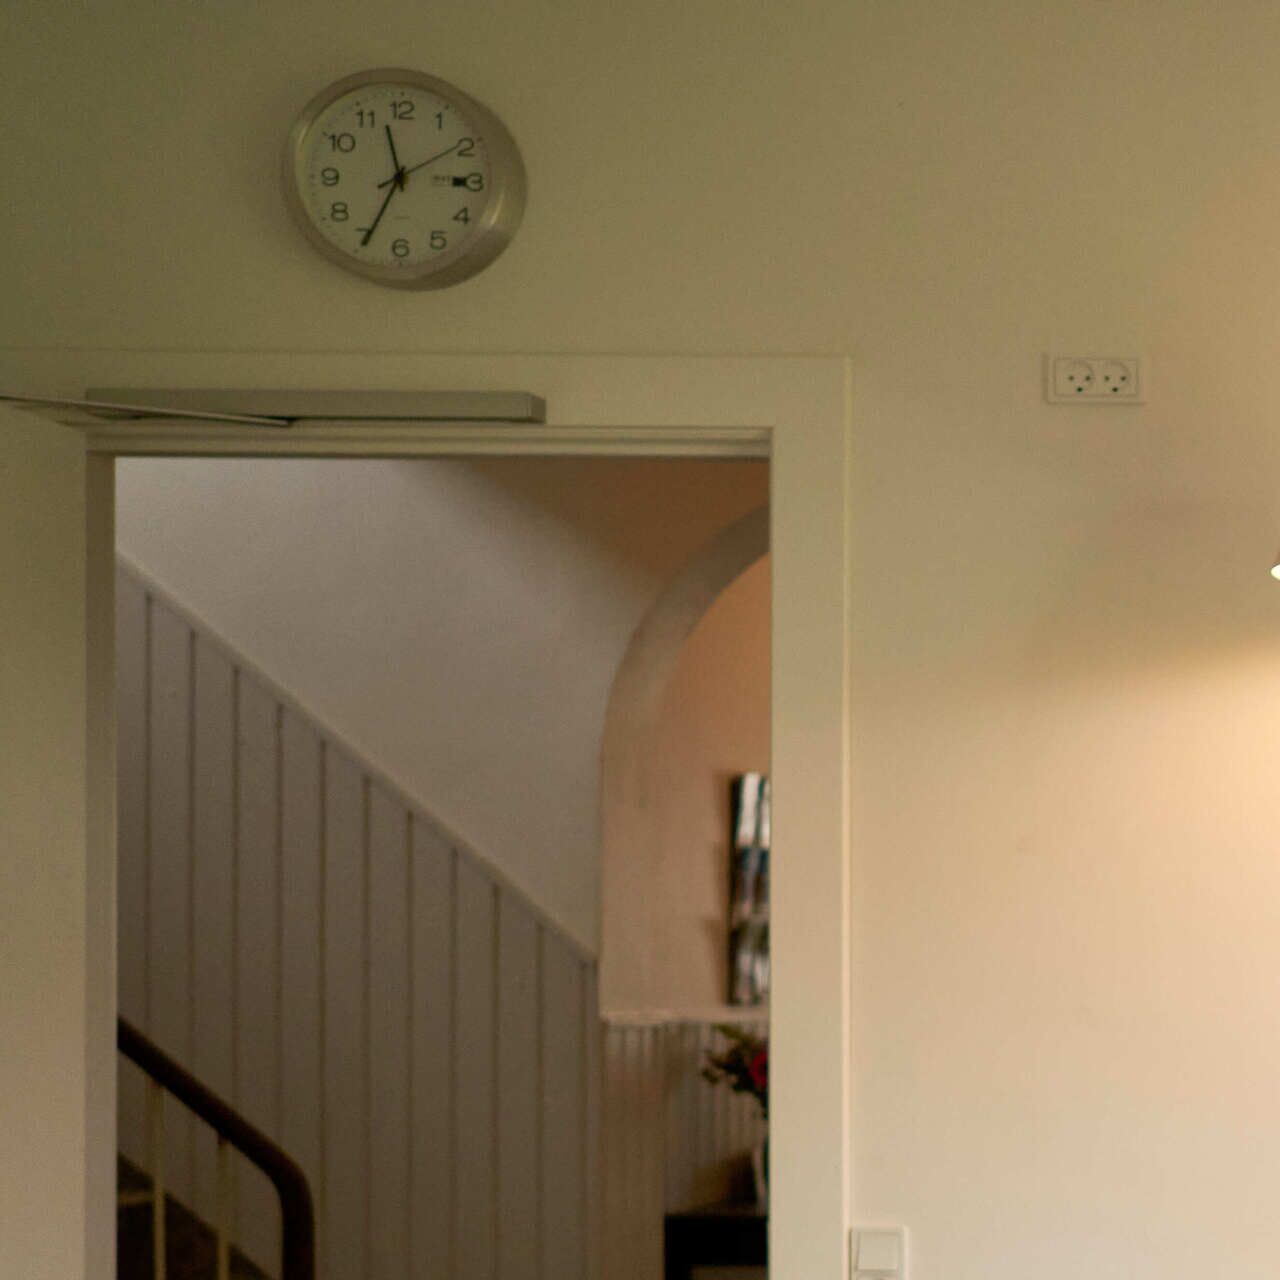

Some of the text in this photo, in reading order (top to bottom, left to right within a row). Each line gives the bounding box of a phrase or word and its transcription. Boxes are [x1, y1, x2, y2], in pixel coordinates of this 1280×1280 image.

[356, 110, 376, 128] 11
[389, 100, 415, 120] 12
[435, 111, 443, 130] 1
[328, 132, 356, 153] 10
[455, 137, 475, 157] 2
[321, 167, 340, 186] 9
[465, 172, 484, 192] 3
[330, 202, 349, 222] 8
[453, 207, 470, 225] 4
[392, 238, 410, 258] 6
[430, 231, 447, 250] 5
